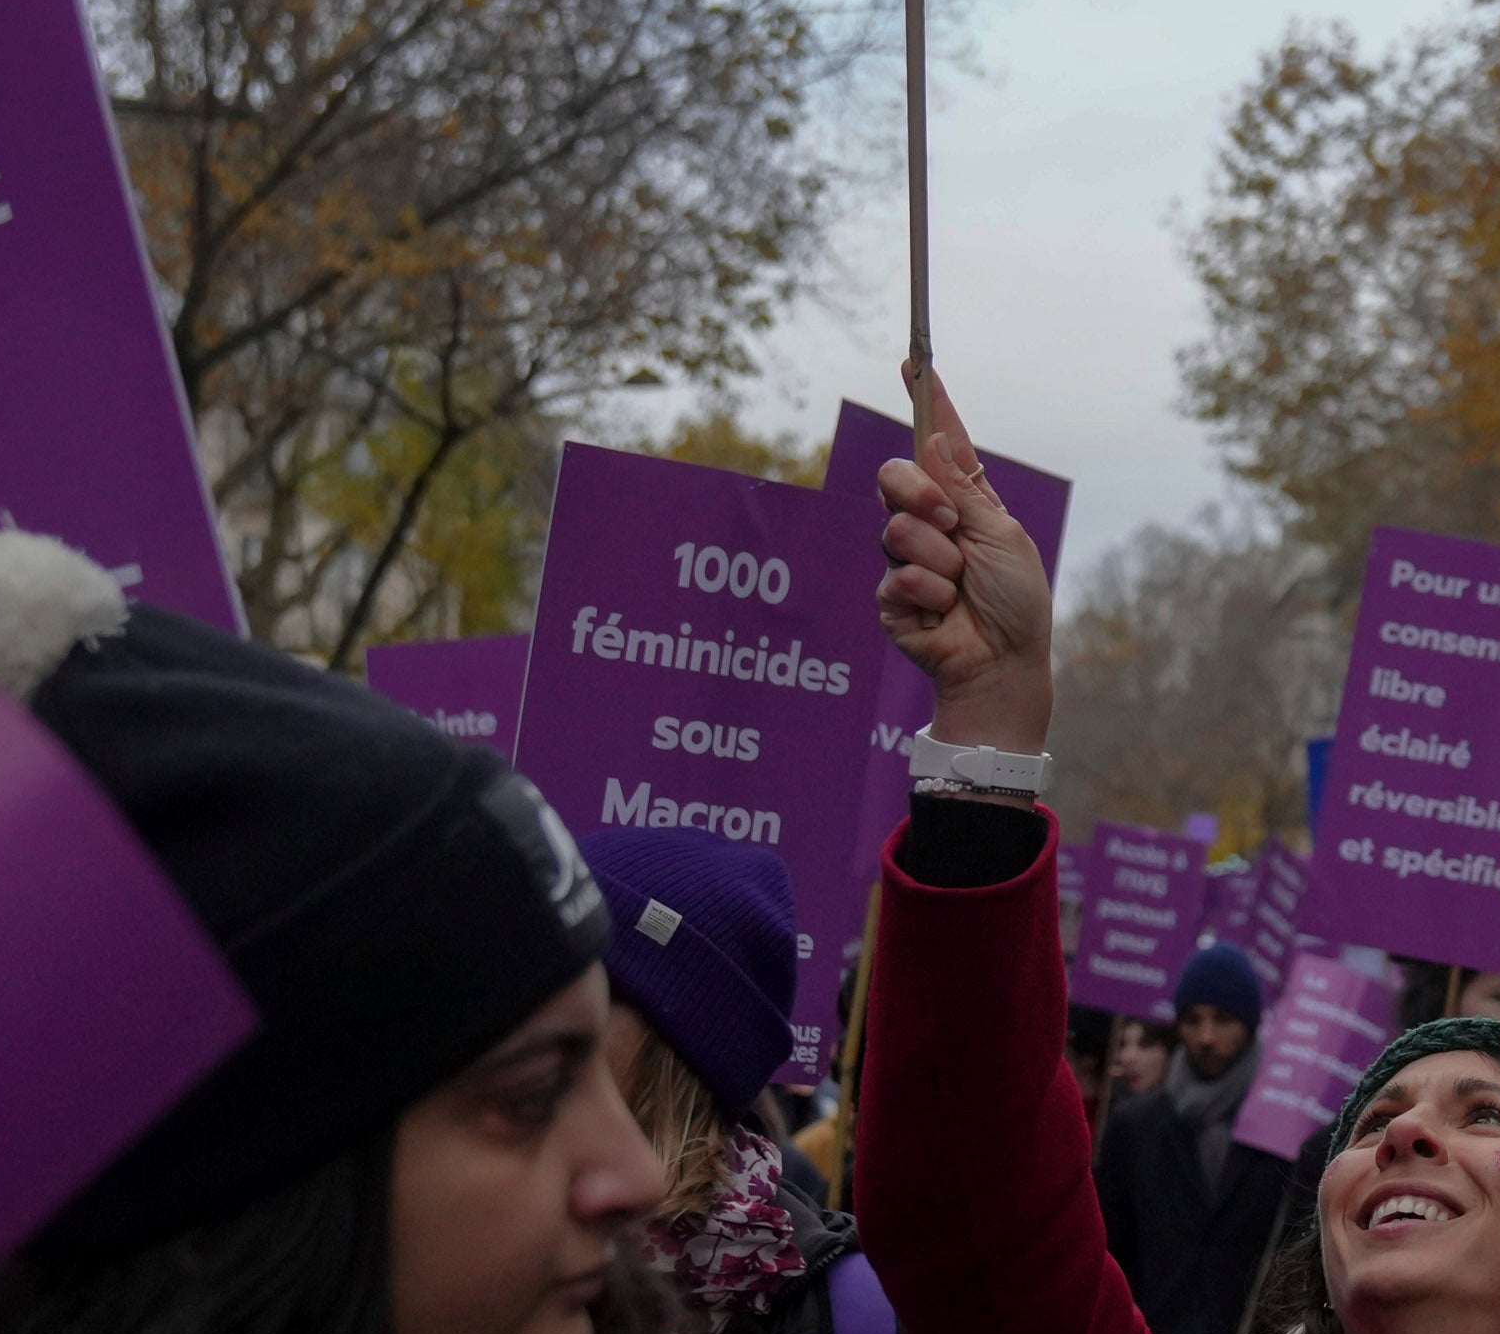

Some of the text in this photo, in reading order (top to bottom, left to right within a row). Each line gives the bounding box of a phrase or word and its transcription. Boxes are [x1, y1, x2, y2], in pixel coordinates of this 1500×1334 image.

[673, 539, 791, 605] 1000
[1389, 558, 1470, 600] Pour
[570, 605, 852, 697] féminicides
[1368, 667, 1446, 709] libre
[434, 707, 498, 737] inte
[652, 715, 761, 761] sous
[1359, 724, 1471, 769] éclairé
[601, 777, 781, 845] Macron
[1339, 837, 1374, 863] et
